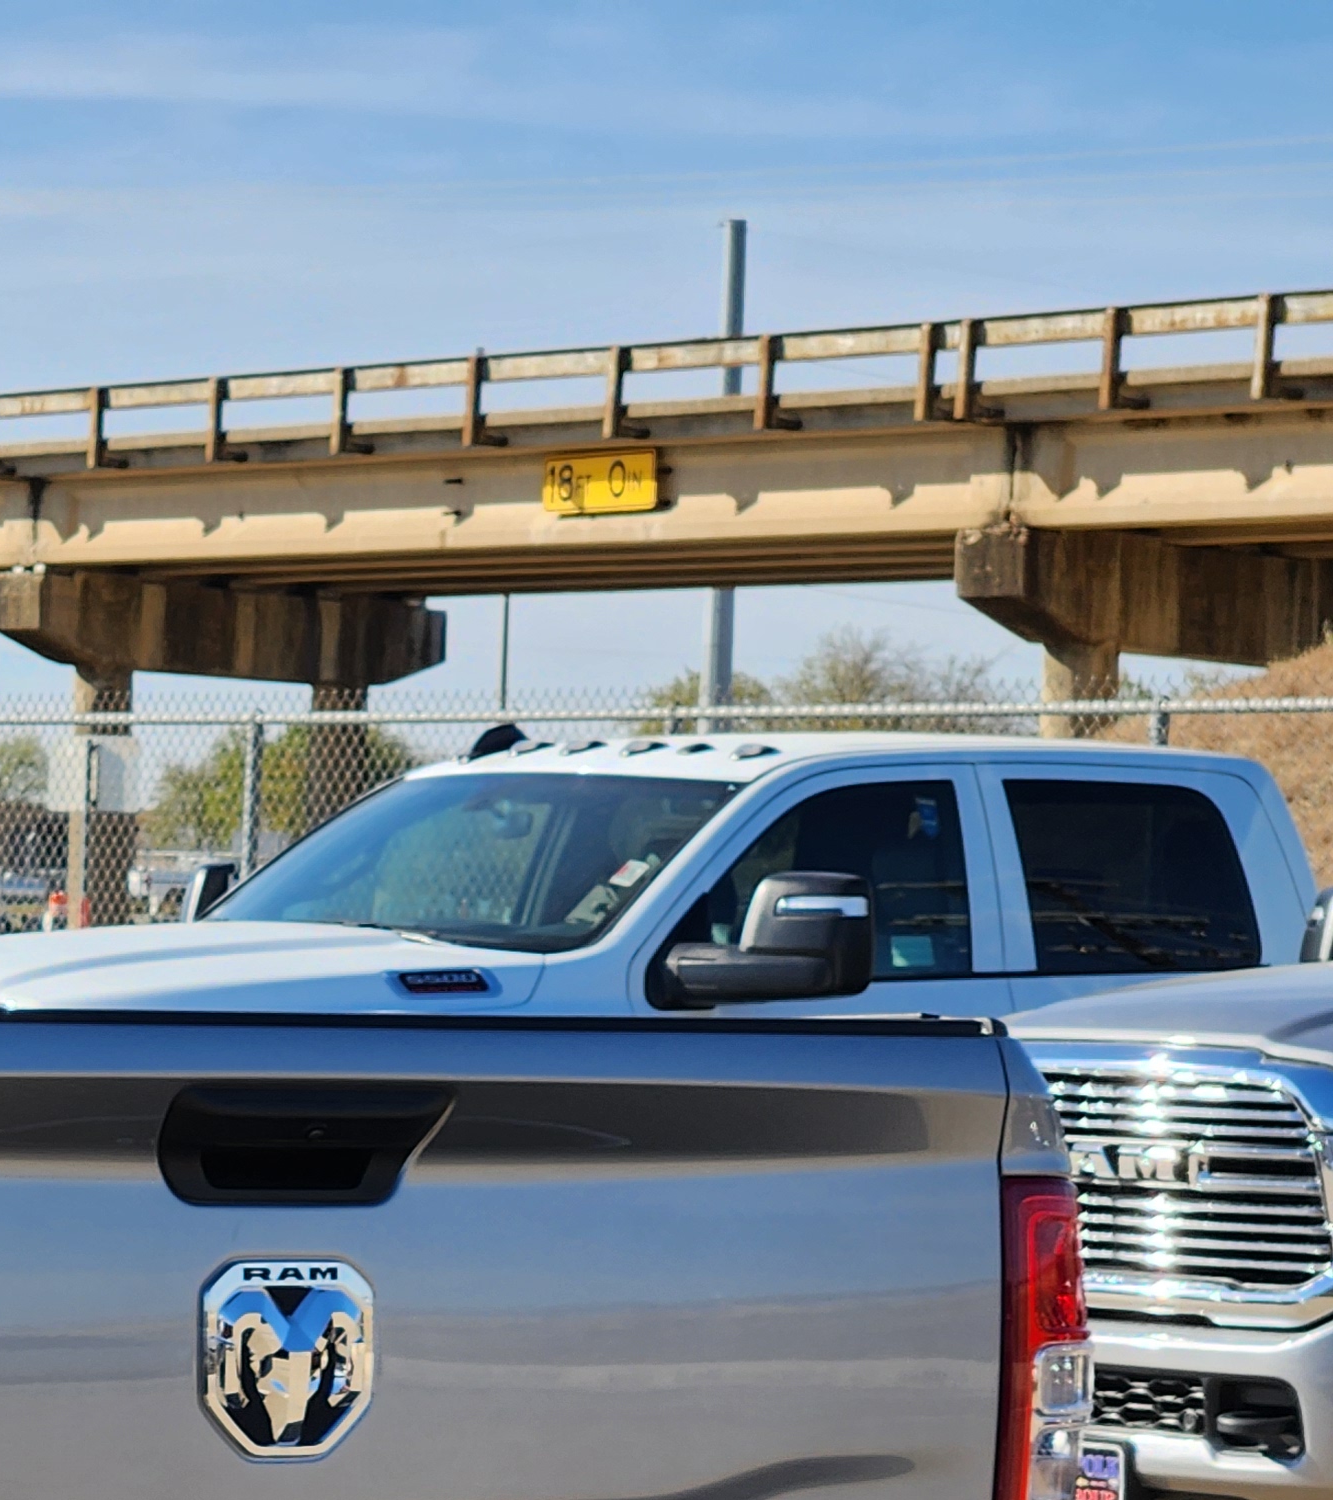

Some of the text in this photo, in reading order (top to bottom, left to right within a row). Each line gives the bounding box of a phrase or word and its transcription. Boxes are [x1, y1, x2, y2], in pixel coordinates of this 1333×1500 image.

[548, 464, 574, 503] 18
[608, 459, 627, 498] 0
[1069, 1143, 1179, 1181] AM
[243, 1267, 339, 1281] RAM
[1081, 1454, 1119, 1478] OLK
